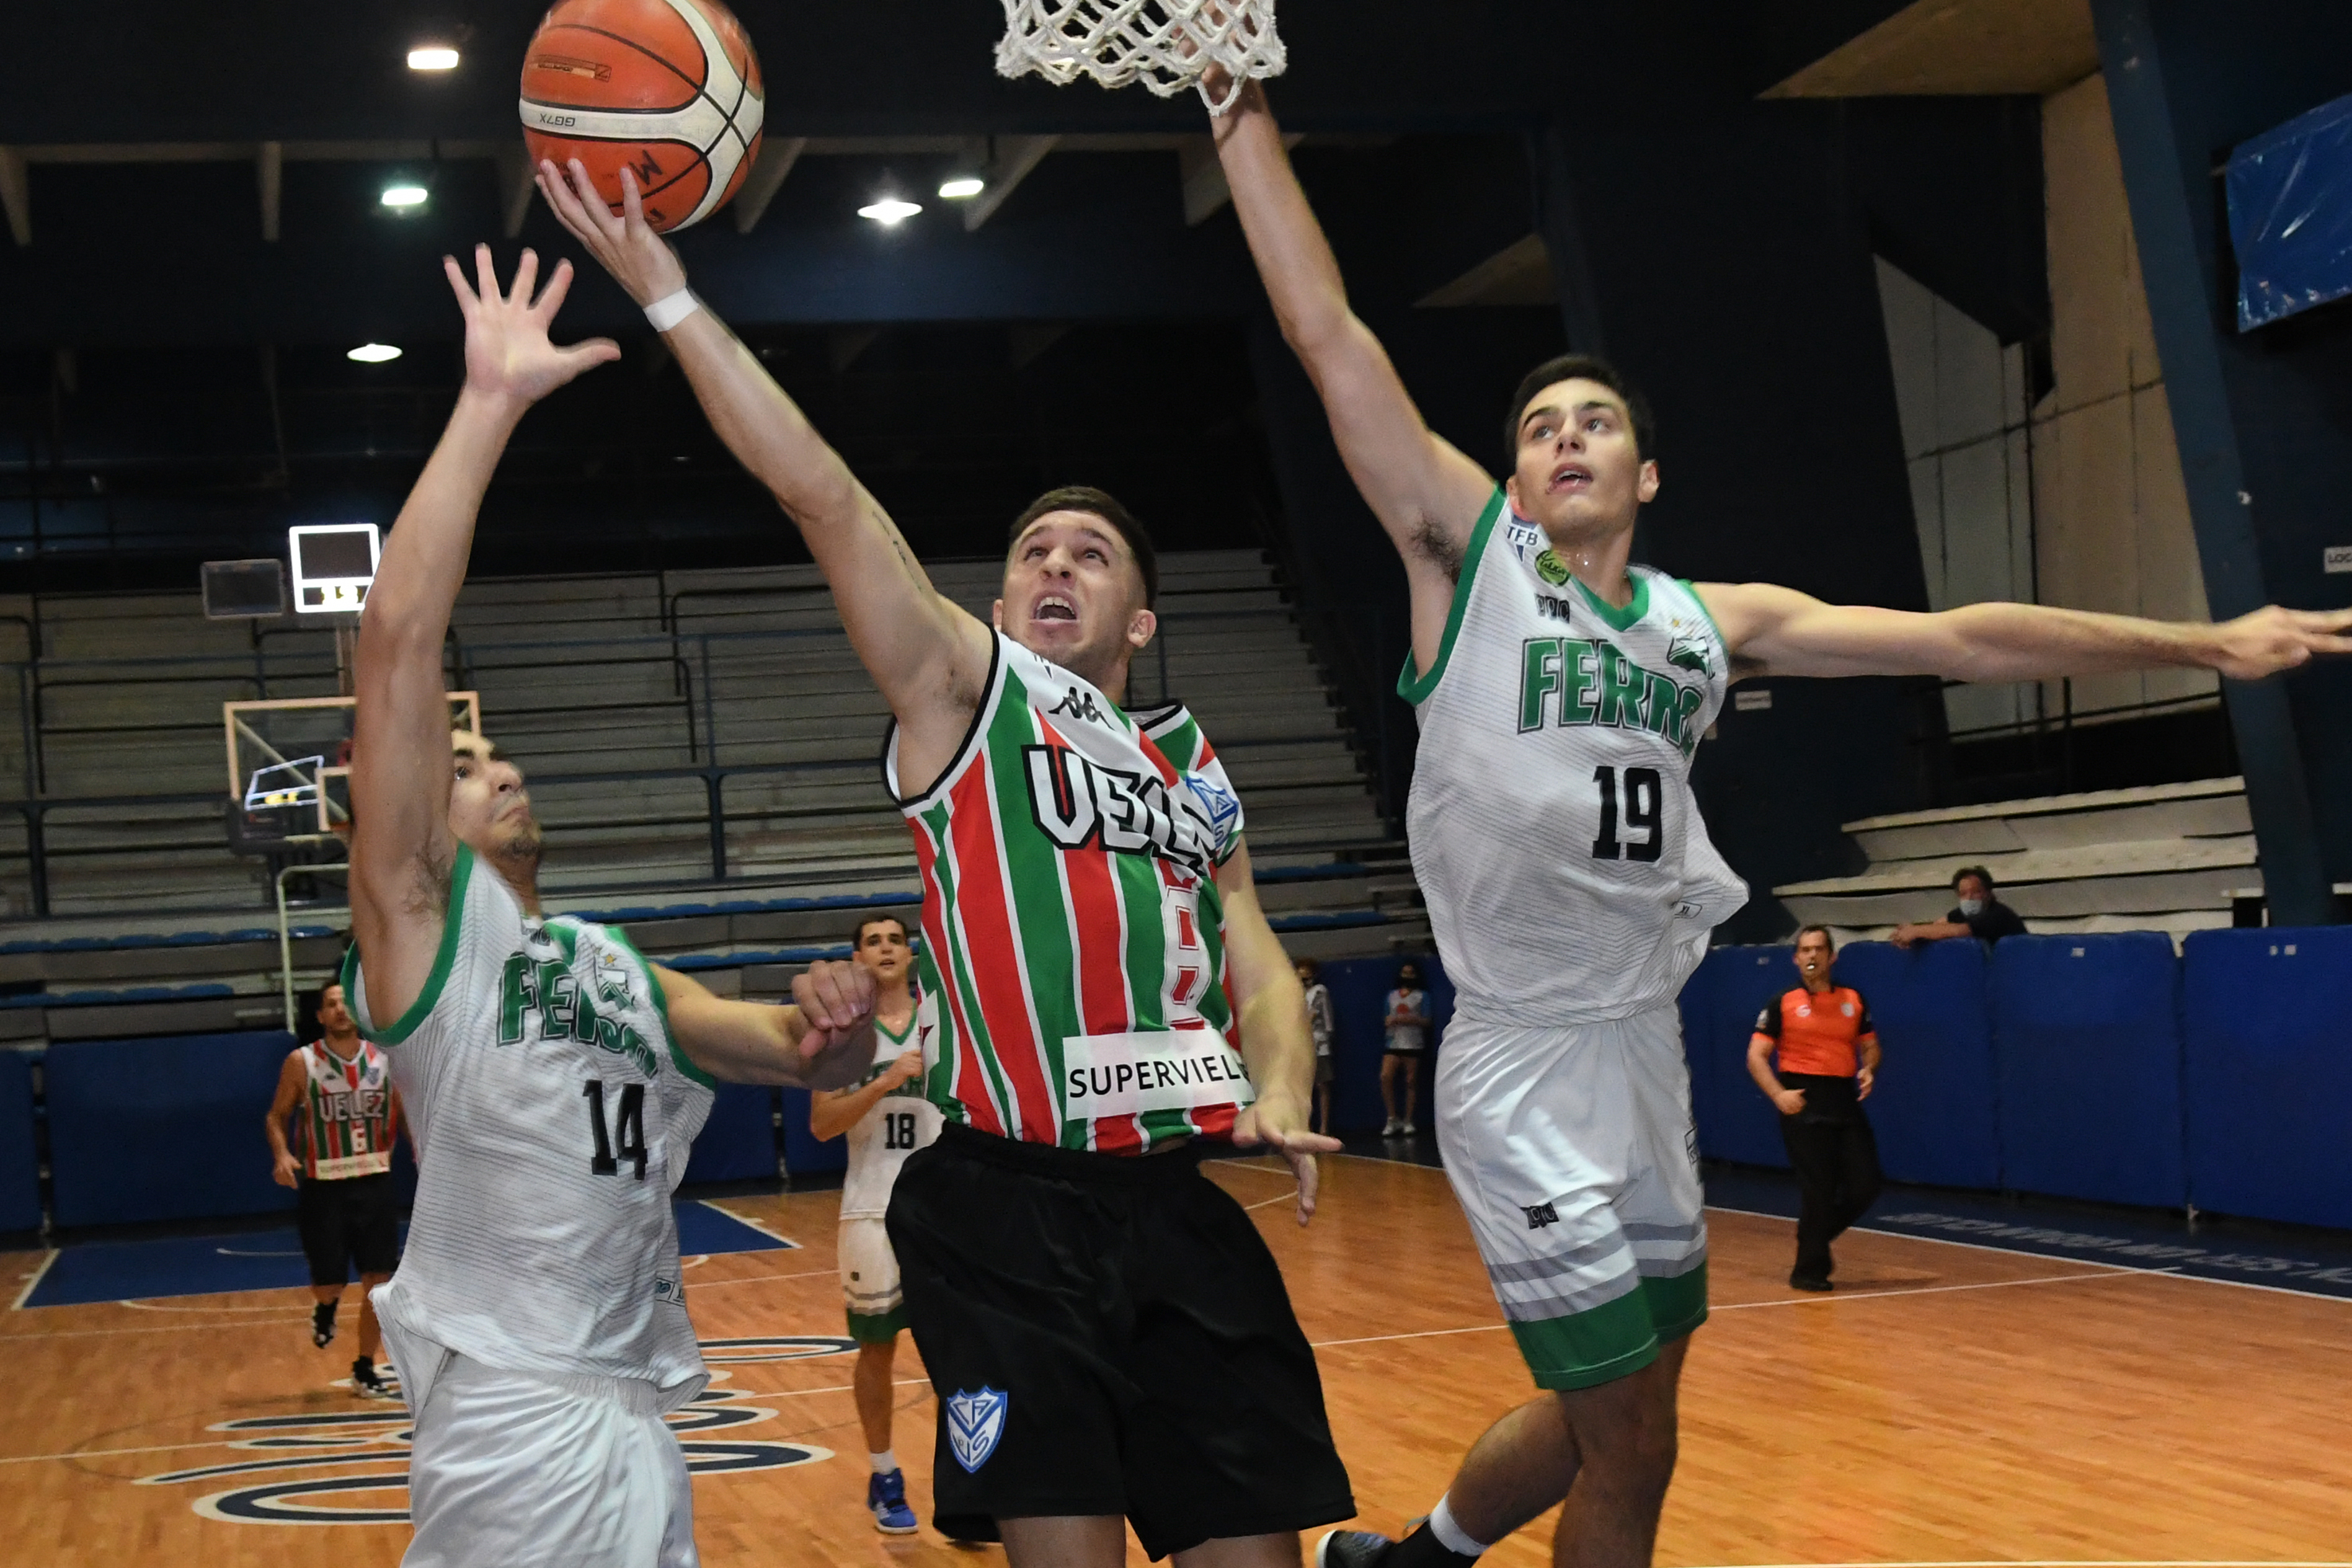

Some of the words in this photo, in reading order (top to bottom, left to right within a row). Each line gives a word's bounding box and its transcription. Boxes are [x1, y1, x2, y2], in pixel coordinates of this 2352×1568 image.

[539, 112, 576, 127] GG7X
[1507, 524, 1539, 546] TFB
[1592, 765, 1662, 862] 19
[582, 1078, 648, 1180] 14
[884, 1112, 915, 1149] 18
